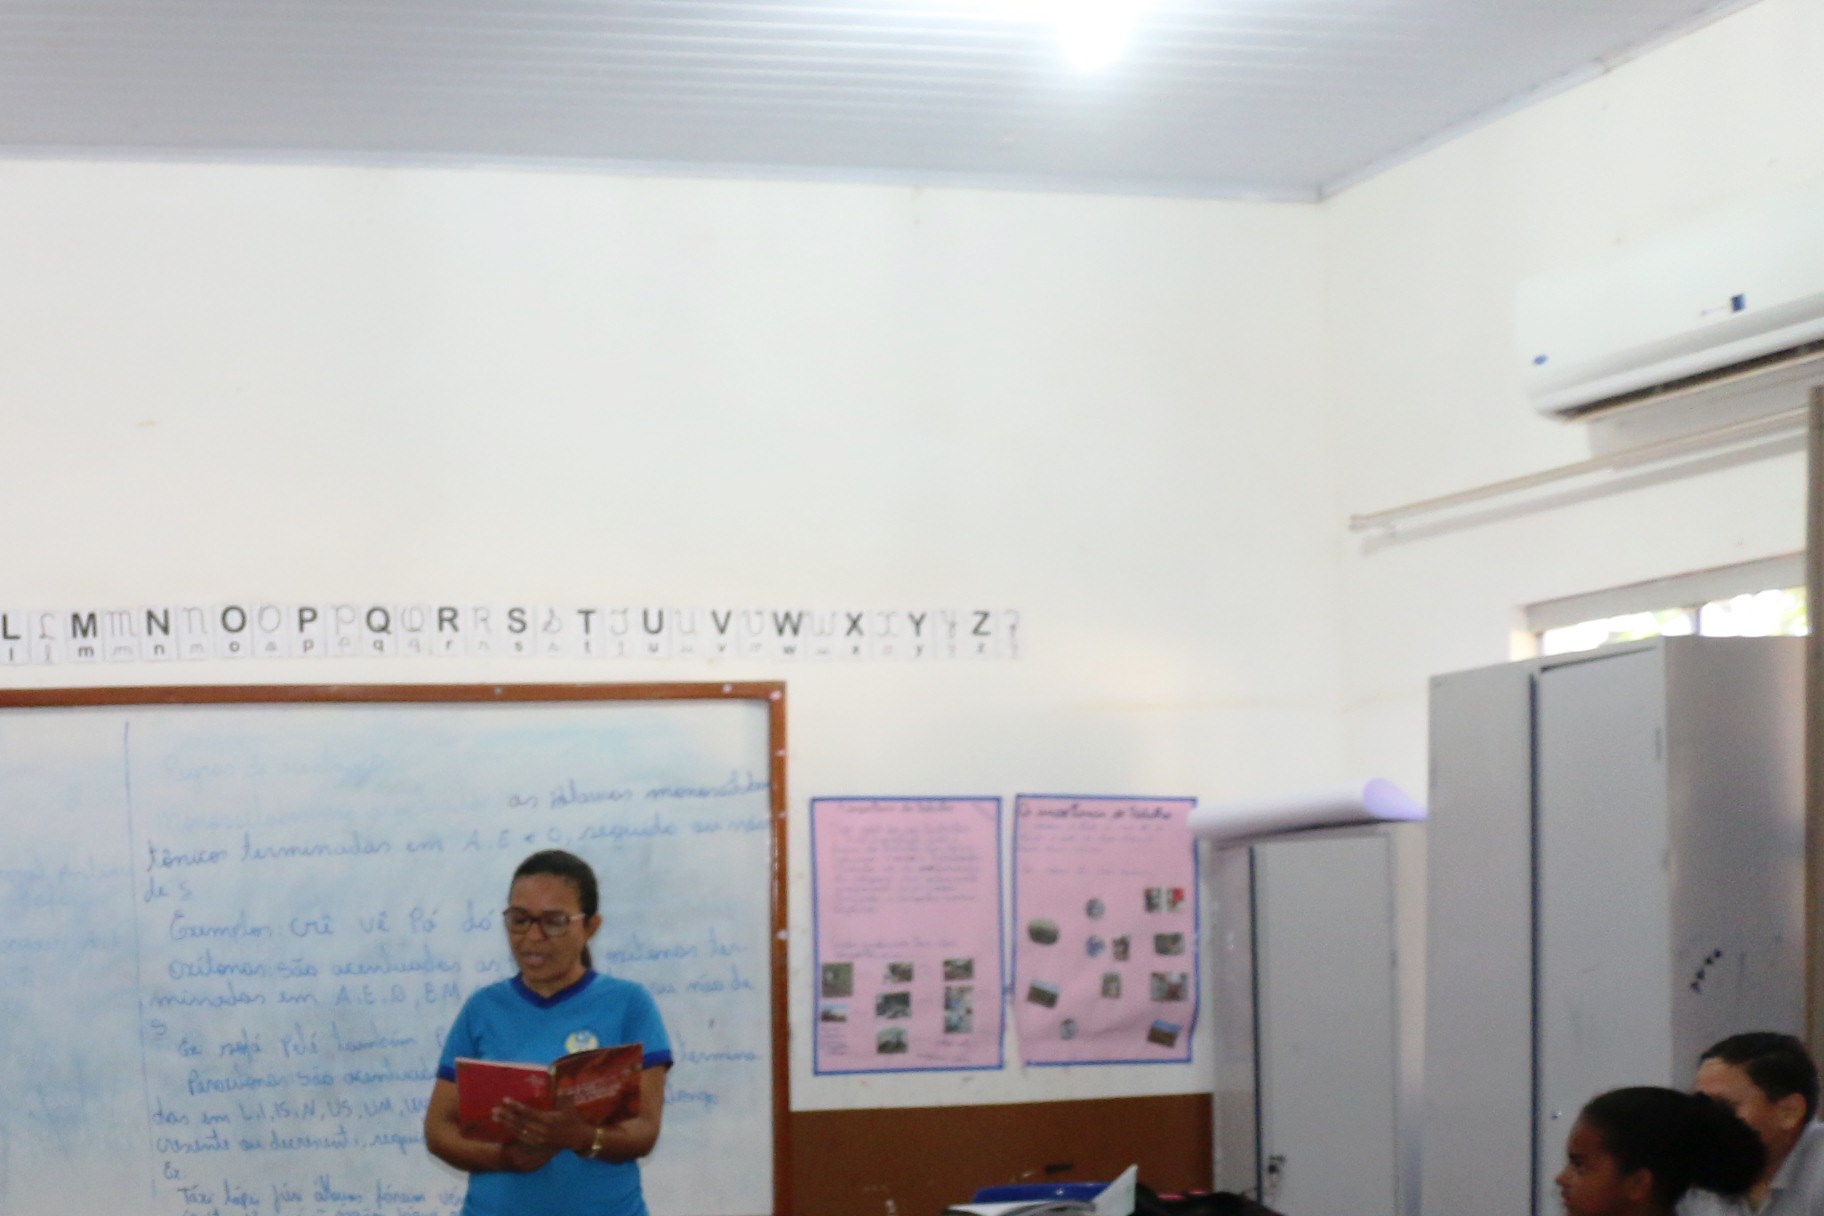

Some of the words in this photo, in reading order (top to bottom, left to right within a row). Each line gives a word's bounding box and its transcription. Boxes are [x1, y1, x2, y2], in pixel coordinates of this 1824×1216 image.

[2, 614, 20, 640] L
[72, 613, 96, 637] M
[147, 610, 169, 635] N
[221, 606, 246, 633] O
[299, 607, 317, 632] P
[366, 608, 390, 633] Q
[438, 607, 458, 631] R
[508, 608, 527, 633] S
[578, 610, 595, 633] T
[643, 609, 663, 634] U
[712, 611, 731, 634] V
[775, 612, 802, 635] W
[844, 610, 864, 638] X
[907, 610, 927, 637] Y
[973, 611, 989, 635] Z
[78, 647, 94, 656] m
[153, 643, 165, 656] n
[229, 642, 240, 652] o
[406, 839, 444, 854] em
